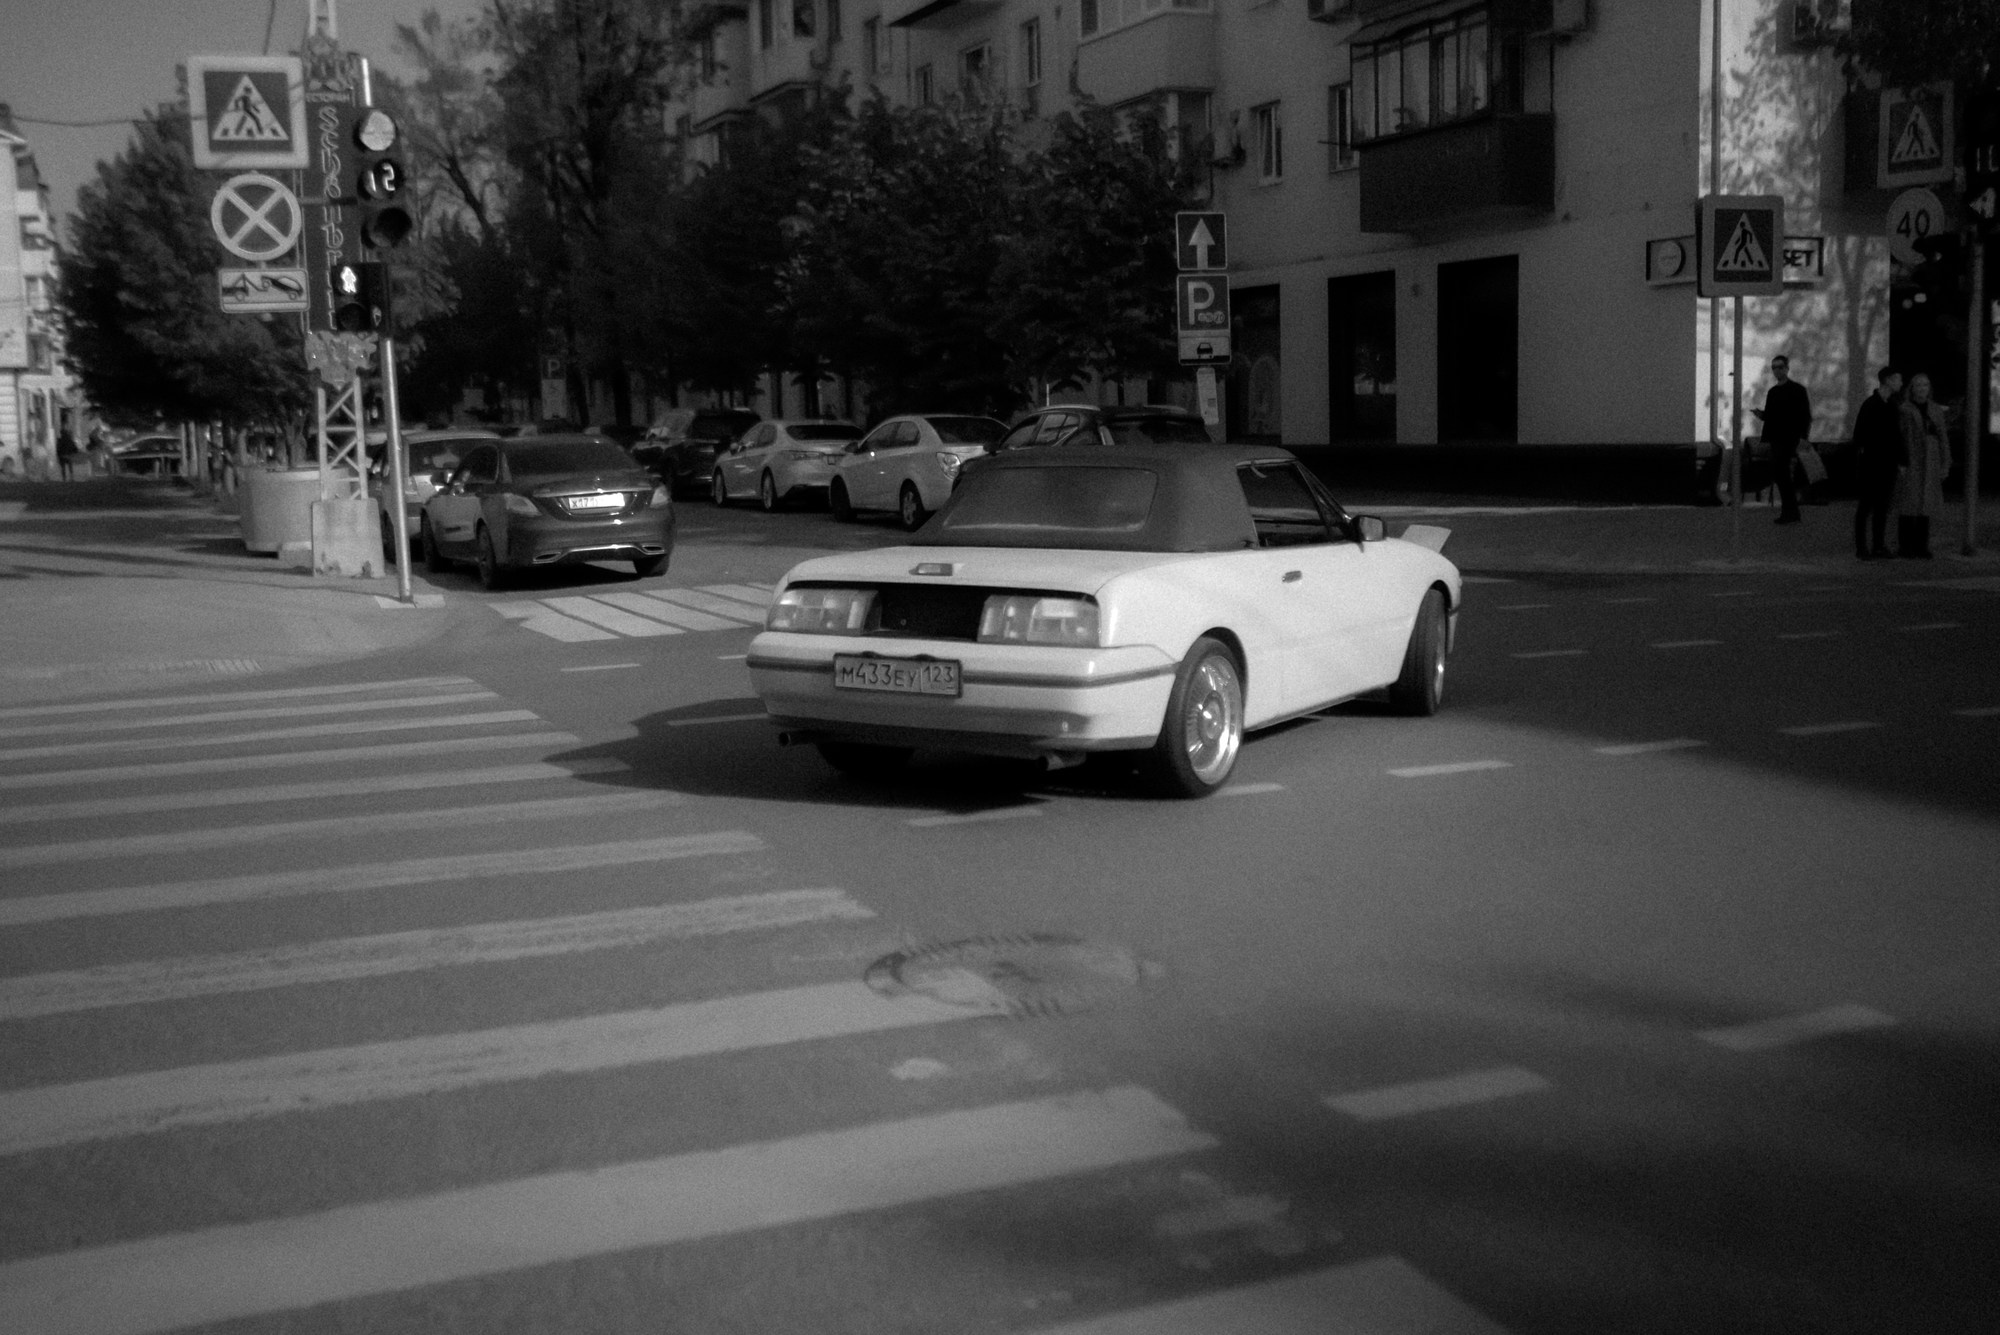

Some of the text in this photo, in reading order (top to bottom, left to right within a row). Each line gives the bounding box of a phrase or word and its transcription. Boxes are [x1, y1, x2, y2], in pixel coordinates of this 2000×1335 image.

[367, 162, 396, 192] 12
[1897, 210, 1930, 238] 40
[1187, 281, 1215, 325] P
[923, 665, 954, 683] 123
